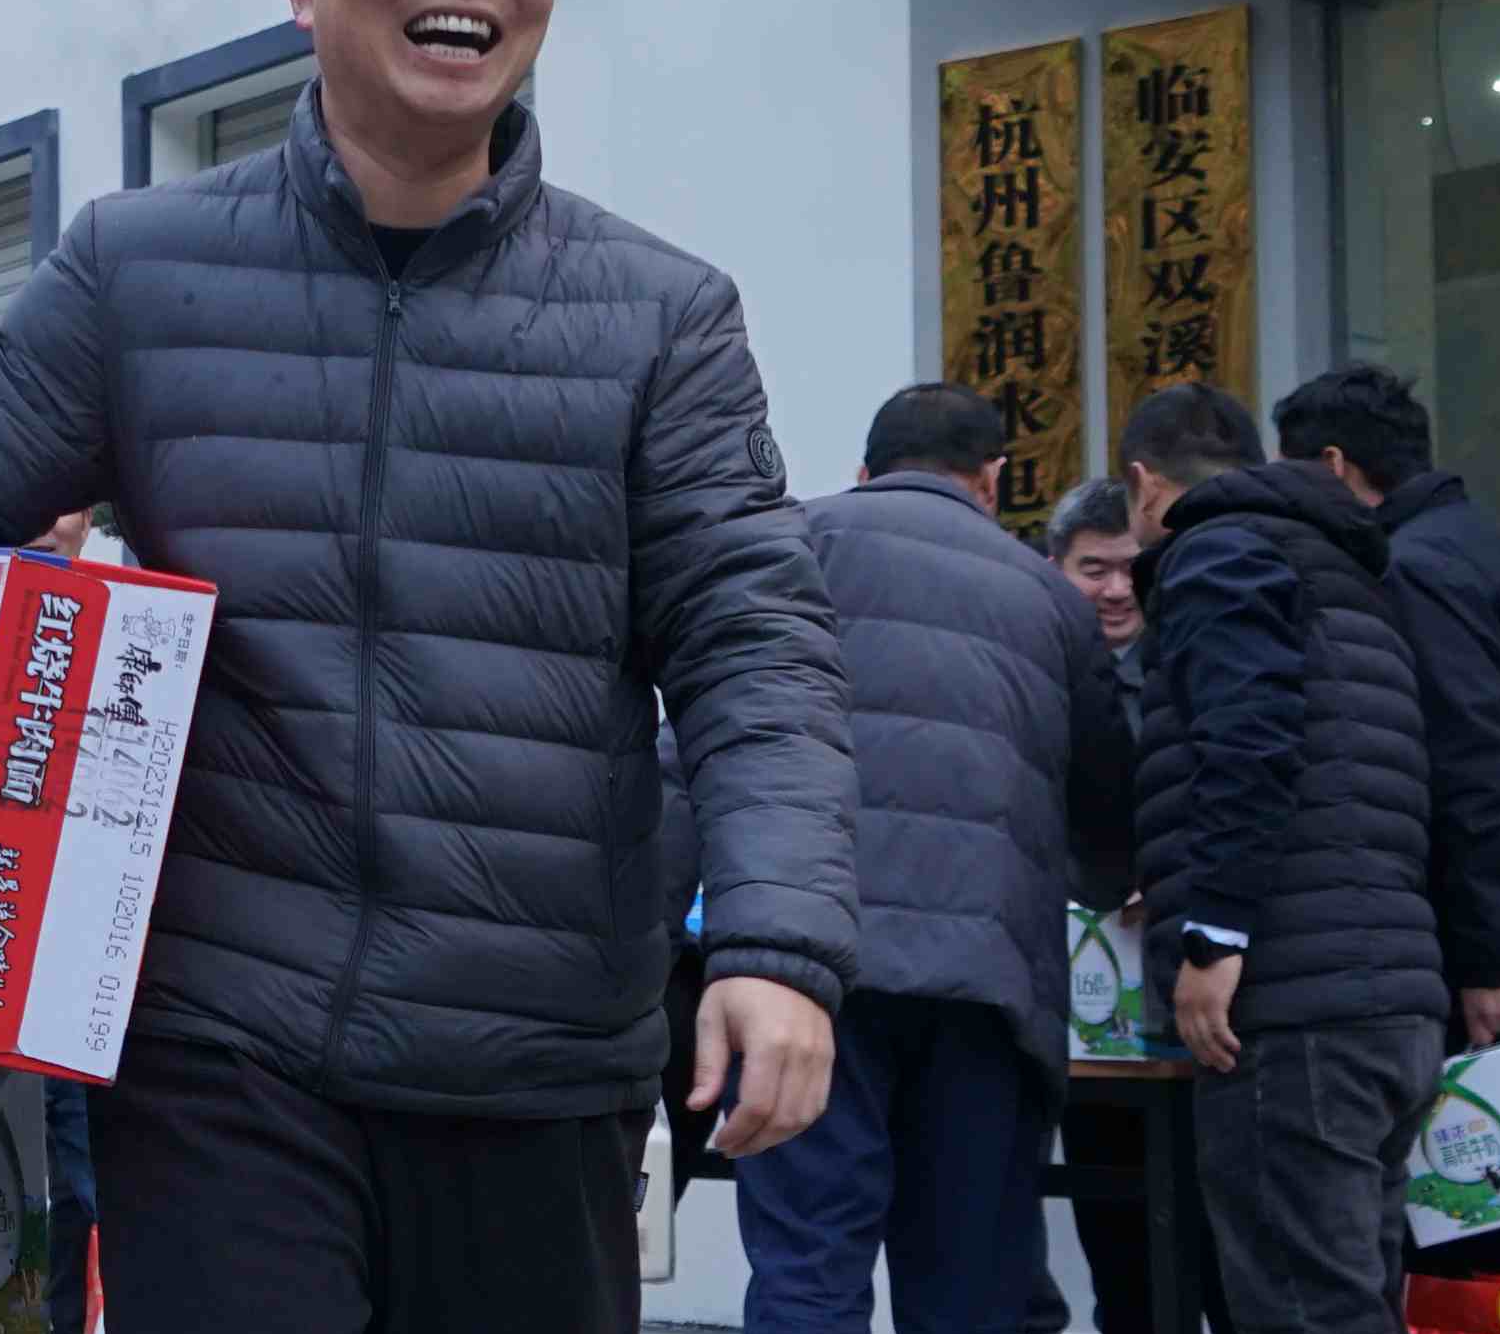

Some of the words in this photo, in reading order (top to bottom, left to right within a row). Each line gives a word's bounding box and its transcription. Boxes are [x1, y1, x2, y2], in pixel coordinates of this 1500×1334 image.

[969, 99, 1049, 547] 杭州鲁润水电
[1136, 62, 1218, 377] 临安区双溪
[0, 591, 82, 808] 红烧牛肉面
[85, 972, 121, 1053] 01199
[104, 871, 145, 961] 102016
